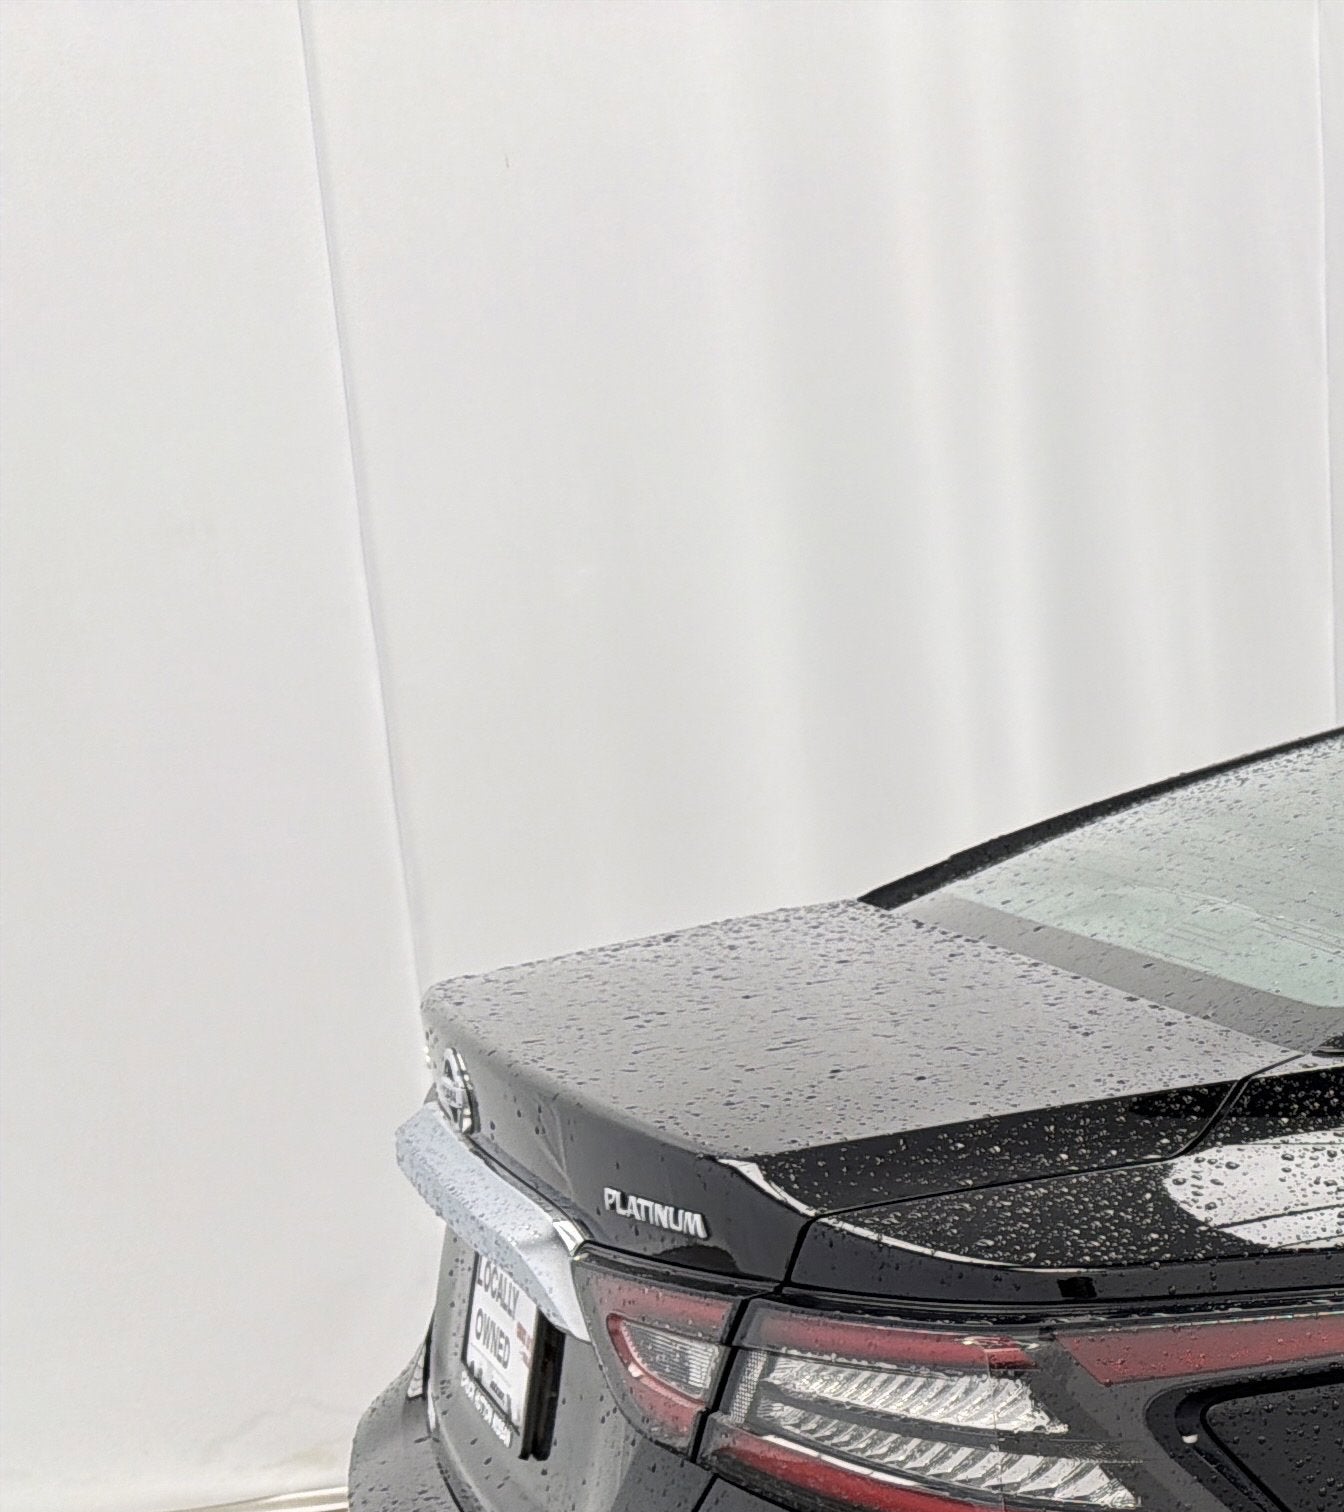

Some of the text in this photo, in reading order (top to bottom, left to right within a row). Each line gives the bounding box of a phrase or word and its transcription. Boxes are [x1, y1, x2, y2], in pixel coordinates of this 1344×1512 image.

[603, 1186, 708, 1239] PLATINUM
[477, 1255, 520, 1321] LOCALLY
[475, 1308, 511, 1369] OWNED
